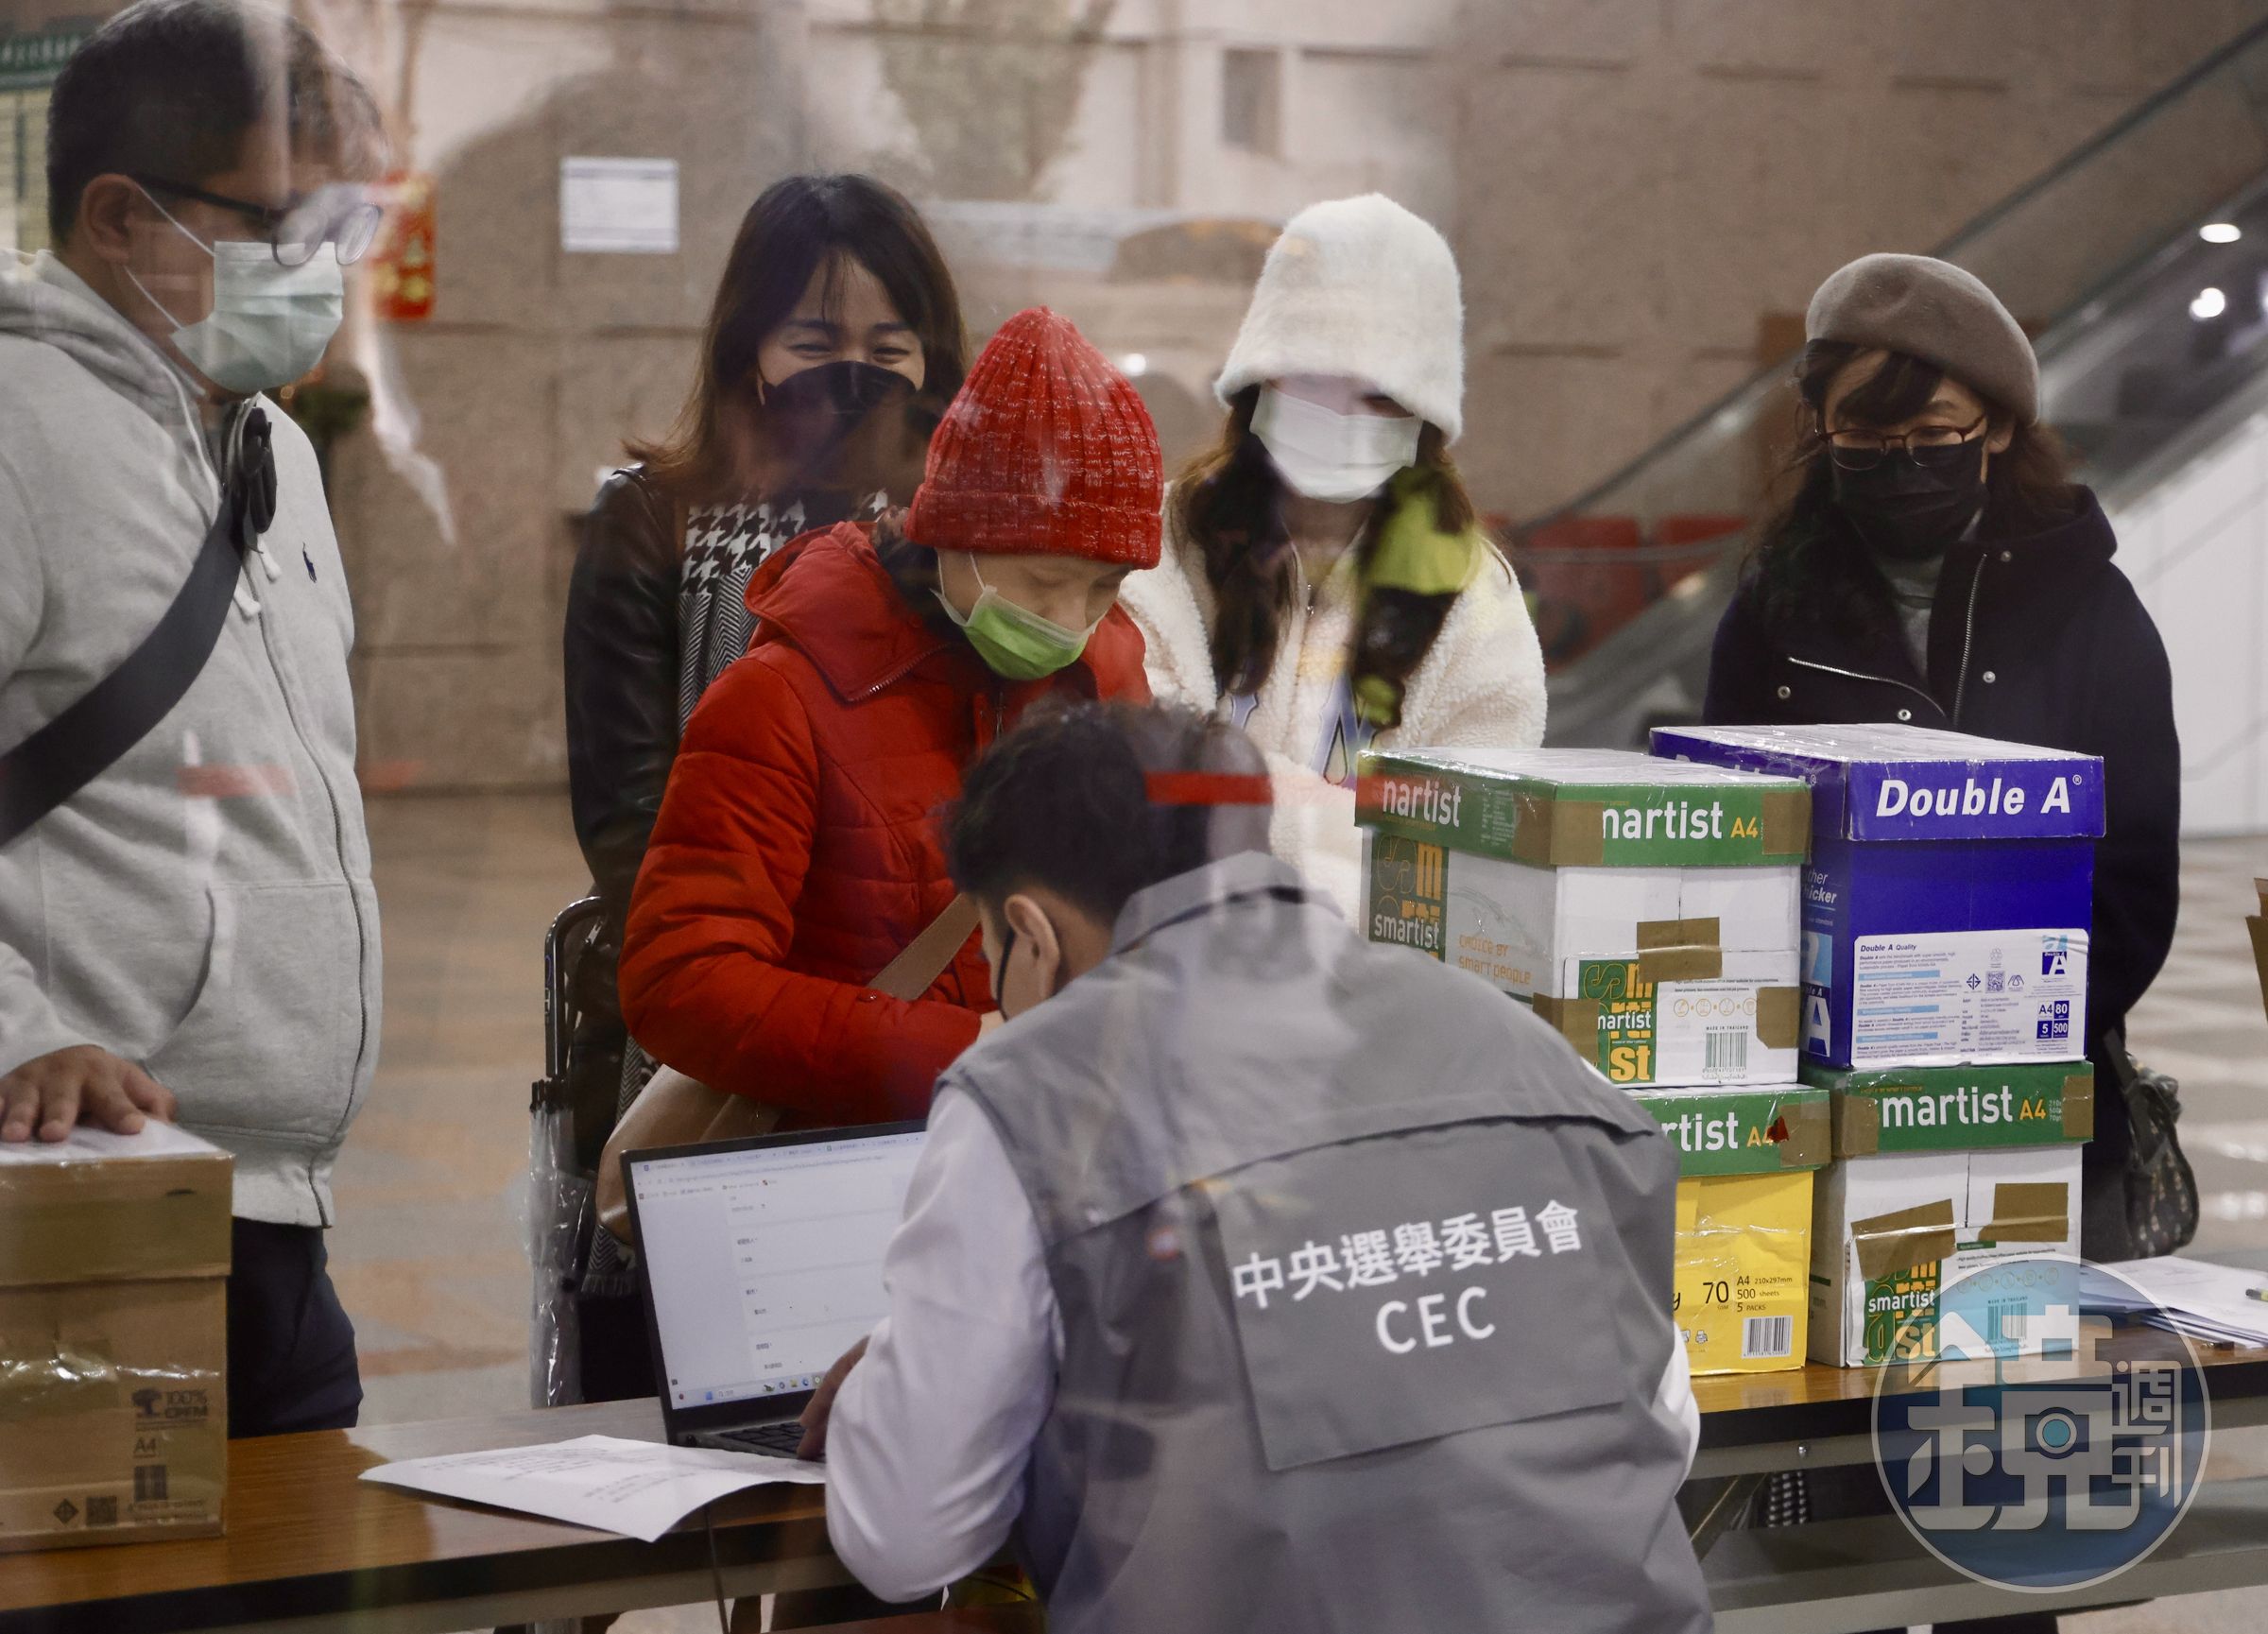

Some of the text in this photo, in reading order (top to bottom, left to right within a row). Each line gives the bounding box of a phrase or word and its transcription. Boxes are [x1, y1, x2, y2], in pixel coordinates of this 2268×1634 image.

[1876, 777, 2025, 817] Double
[1730, 817, 1759, 839] A4
[1374, 913, 1440, 950] smartist
[1860, 944, 1885, 953] Double
[1896, 943, 1916, 952] Quality
[2038, 1003, 2068, 1015] A4 80
[2041, 1023, 2068, 1034] 5 500
[2019, 1098, 2047, 1121] A4
[1232, 1198, 1583, 1309] 中央選舉委員會
[1736, 1275, 1793, 1286] A4 210x297mm
[1702, 1281, 1729, 1305] 70
[1737, 1288, 1756, 1300] 500
[1867, 1287, 1936, 1314] smartist
[1736, 1301, 1744, 1313] 5
[1375, 1286, 1497, 1355] CEC
[135, 1436, 157, 1453] A4
